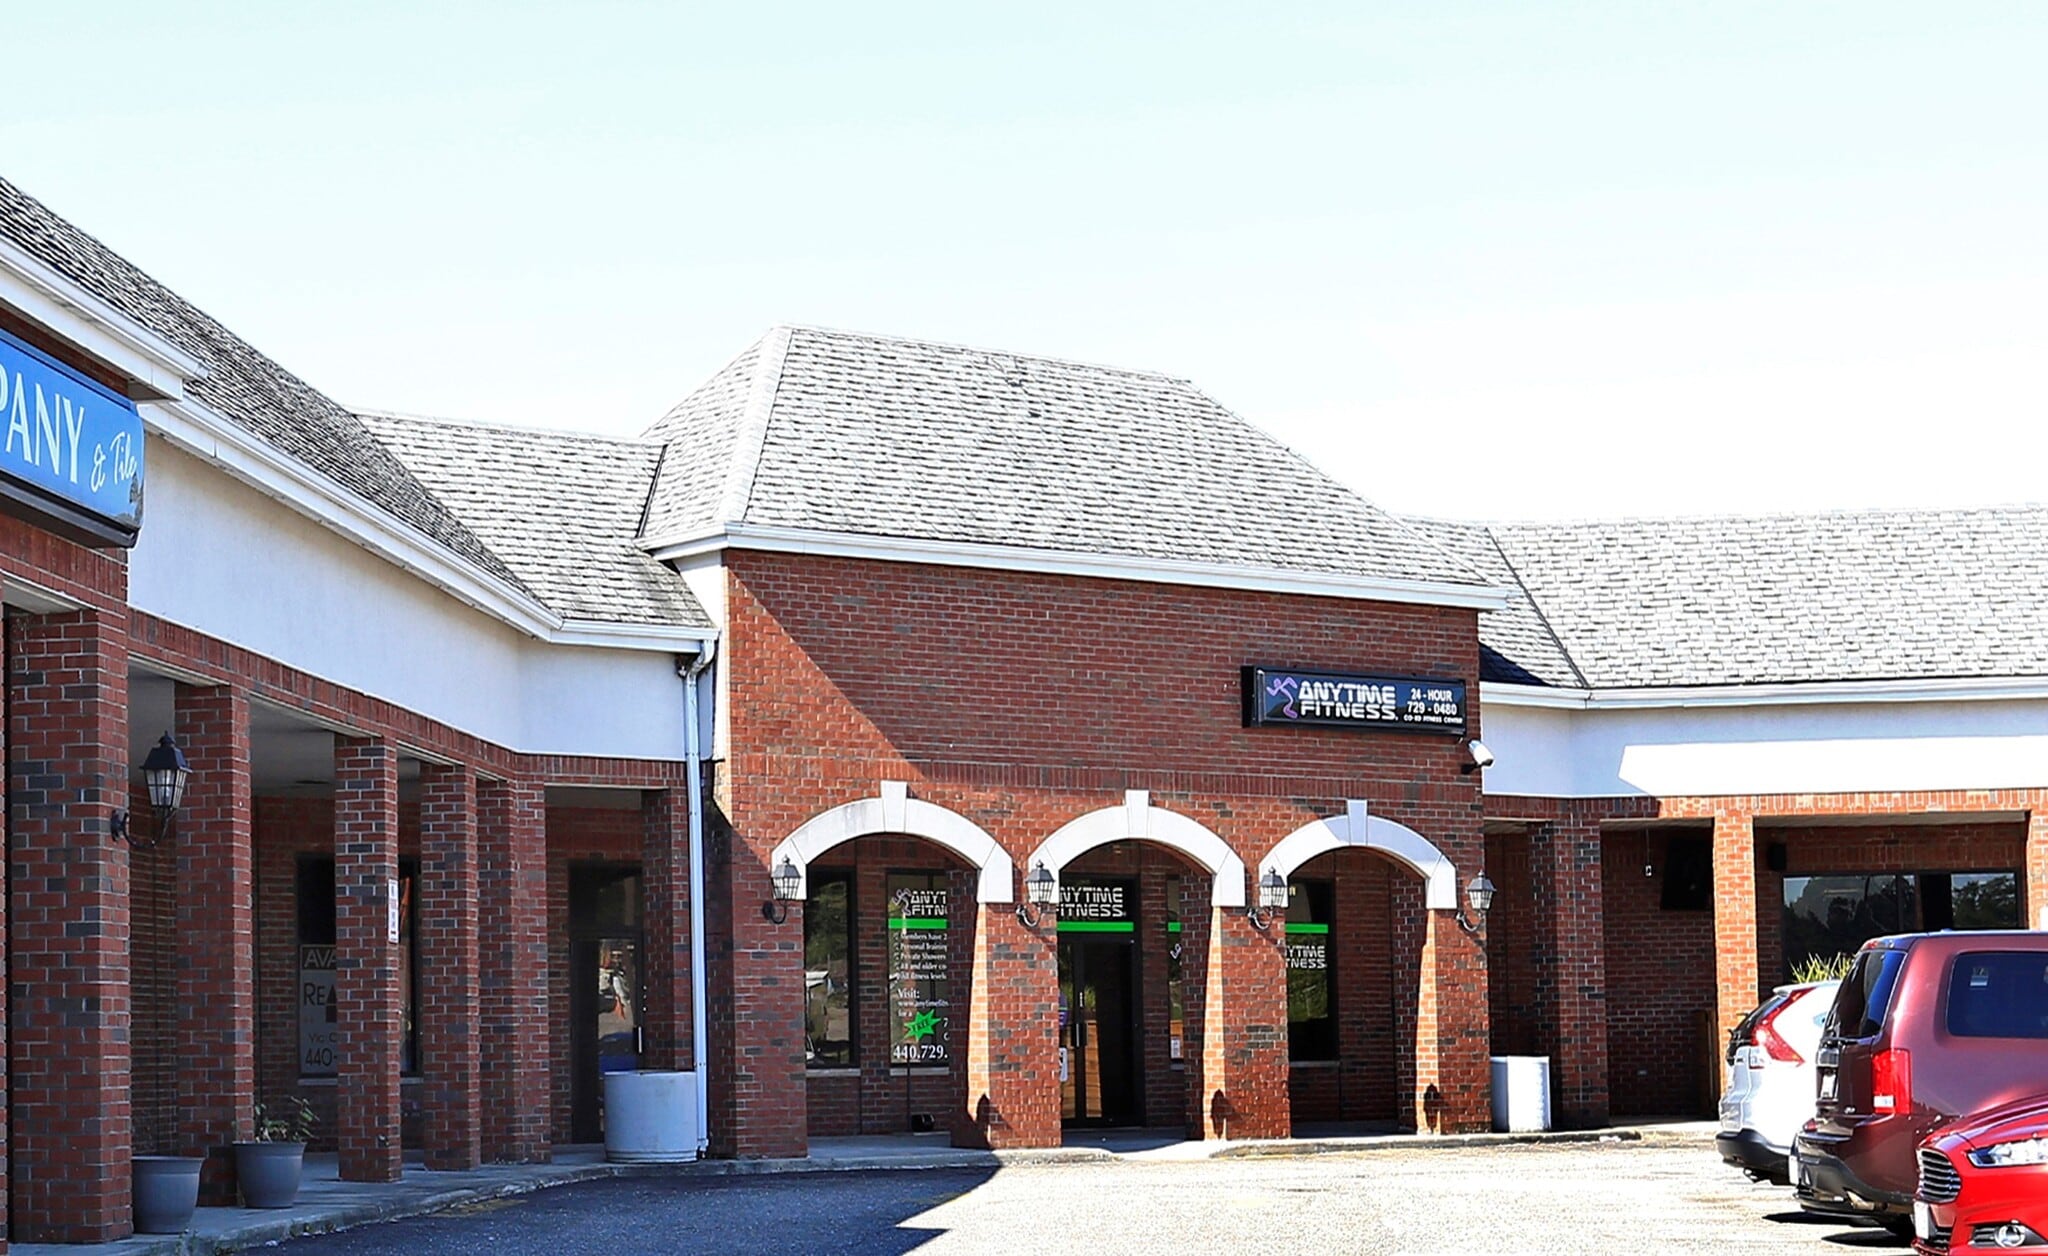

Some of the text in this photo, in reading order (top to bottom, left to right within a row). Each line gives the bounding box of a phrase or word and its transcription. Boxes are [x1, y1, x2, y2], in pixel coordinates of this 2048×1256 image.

[110, 431, 138, 486] Tile
[1298, 680, 1396, 705] ANYTIME
[1300, 701, 1396, 721] FITNESS
[1059, 886, 1123, 903] NYTIME
[303, 948, 337, 969] AVA
[1285, 945, 1325, 958] YTIME
[1285, 958, 1325, 969] TNESS
